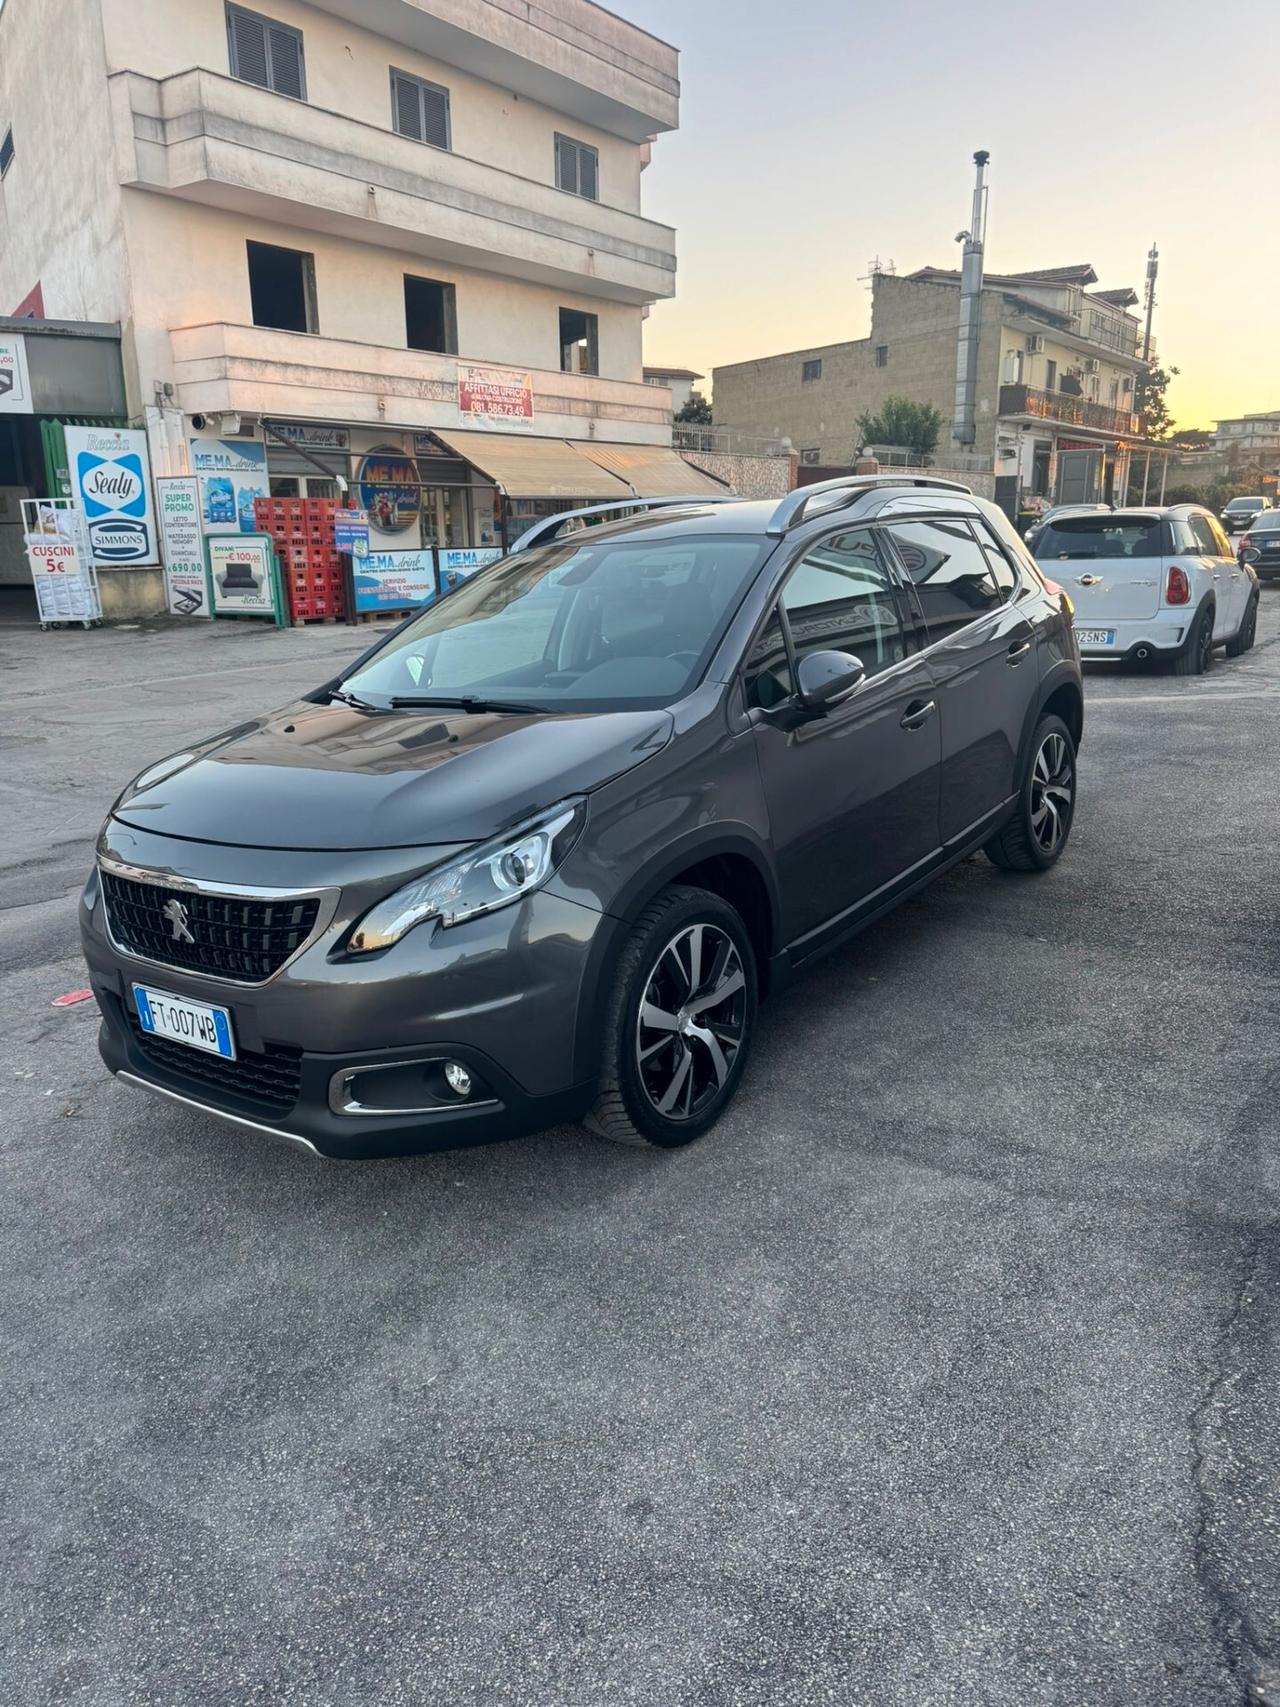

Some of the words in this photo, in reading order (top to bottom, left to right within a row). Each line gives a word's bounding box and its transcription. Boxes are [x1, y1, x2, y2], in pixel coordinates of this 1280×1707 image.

[464, 382, 500, 397] AFFITTASI
[500, 387, 528, 399] UFFICIO
[89, 470, 133, 499] Sealy
[165, 493, 192, 503] SUPER
[164, 503, 195, 513] PROMO
[95, 534, 143, 545] SIMMONS
[32, 546, 75, 557] CUSCINI
